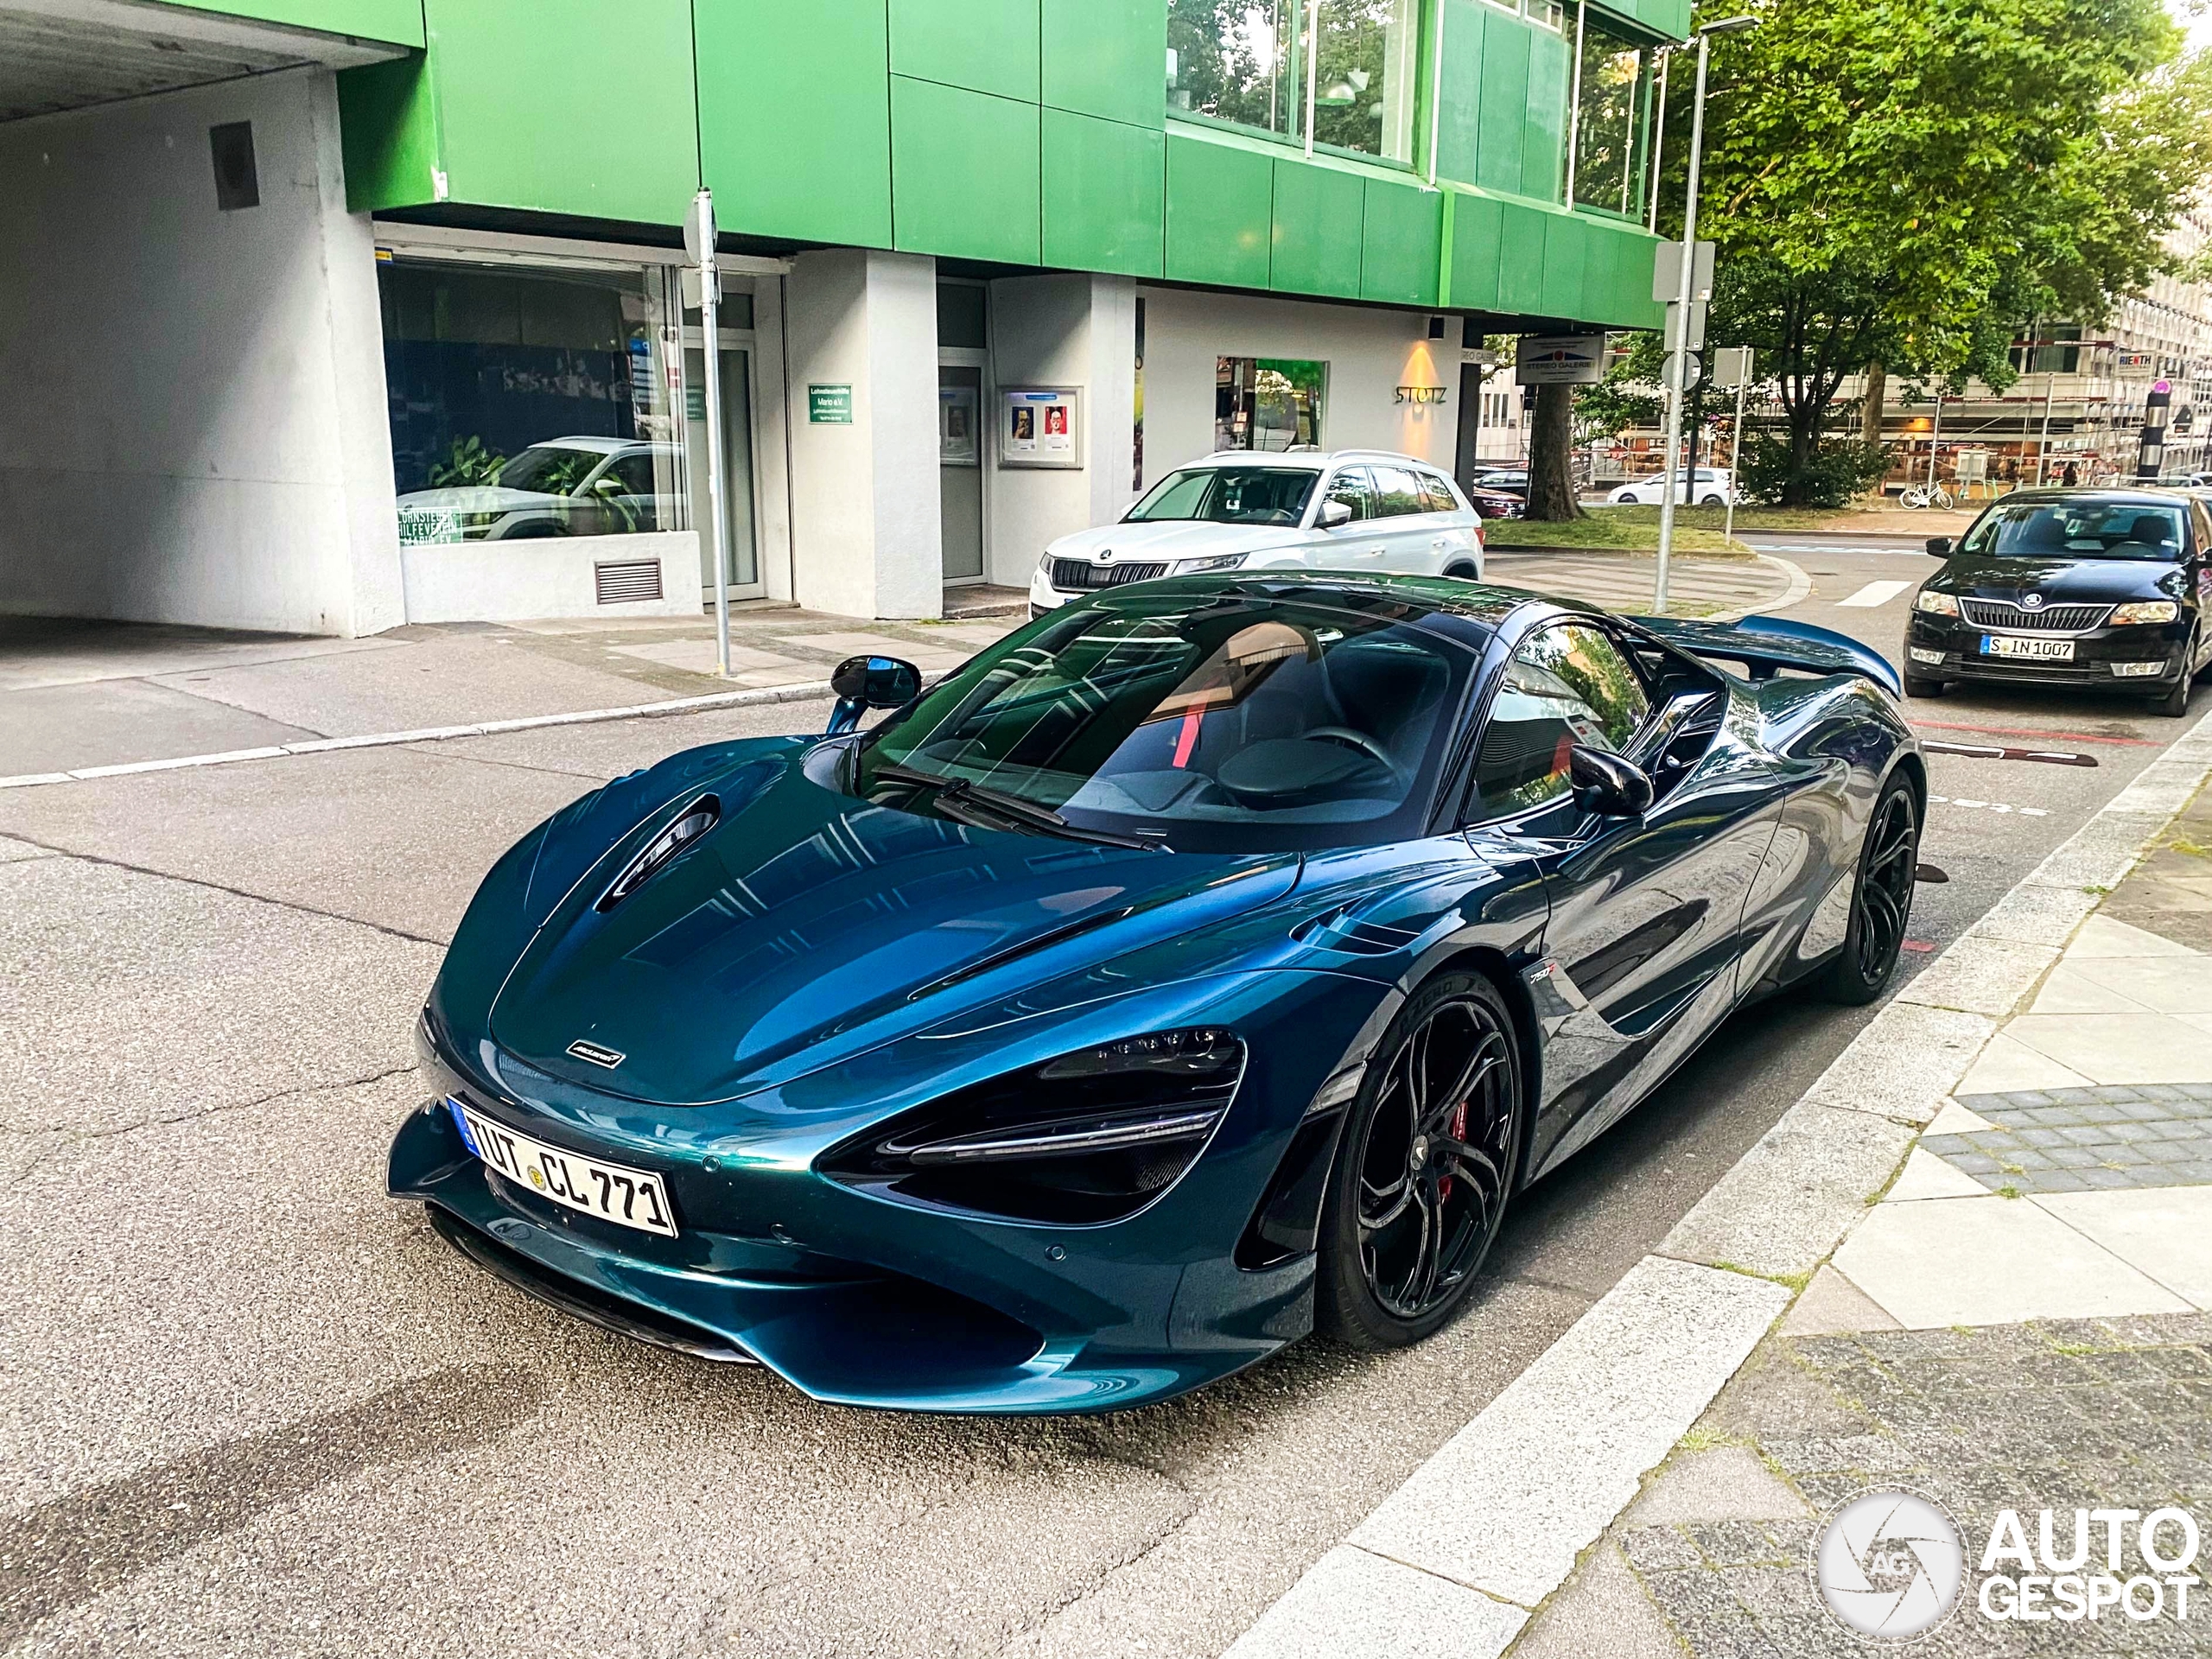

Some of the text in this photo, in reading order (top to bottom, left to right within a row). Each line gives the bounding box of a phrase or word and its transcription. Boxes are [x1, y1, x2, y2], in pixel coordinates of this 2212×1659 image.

[1395, 386, 1447, 404] STOTZ
[1991, 639, 2000, 652] S
[2011, 640, 2031, 654] IN
[2032, 642, 2072, 657] 1007
[466, 1116, 669, 1229] TUT CL 771
